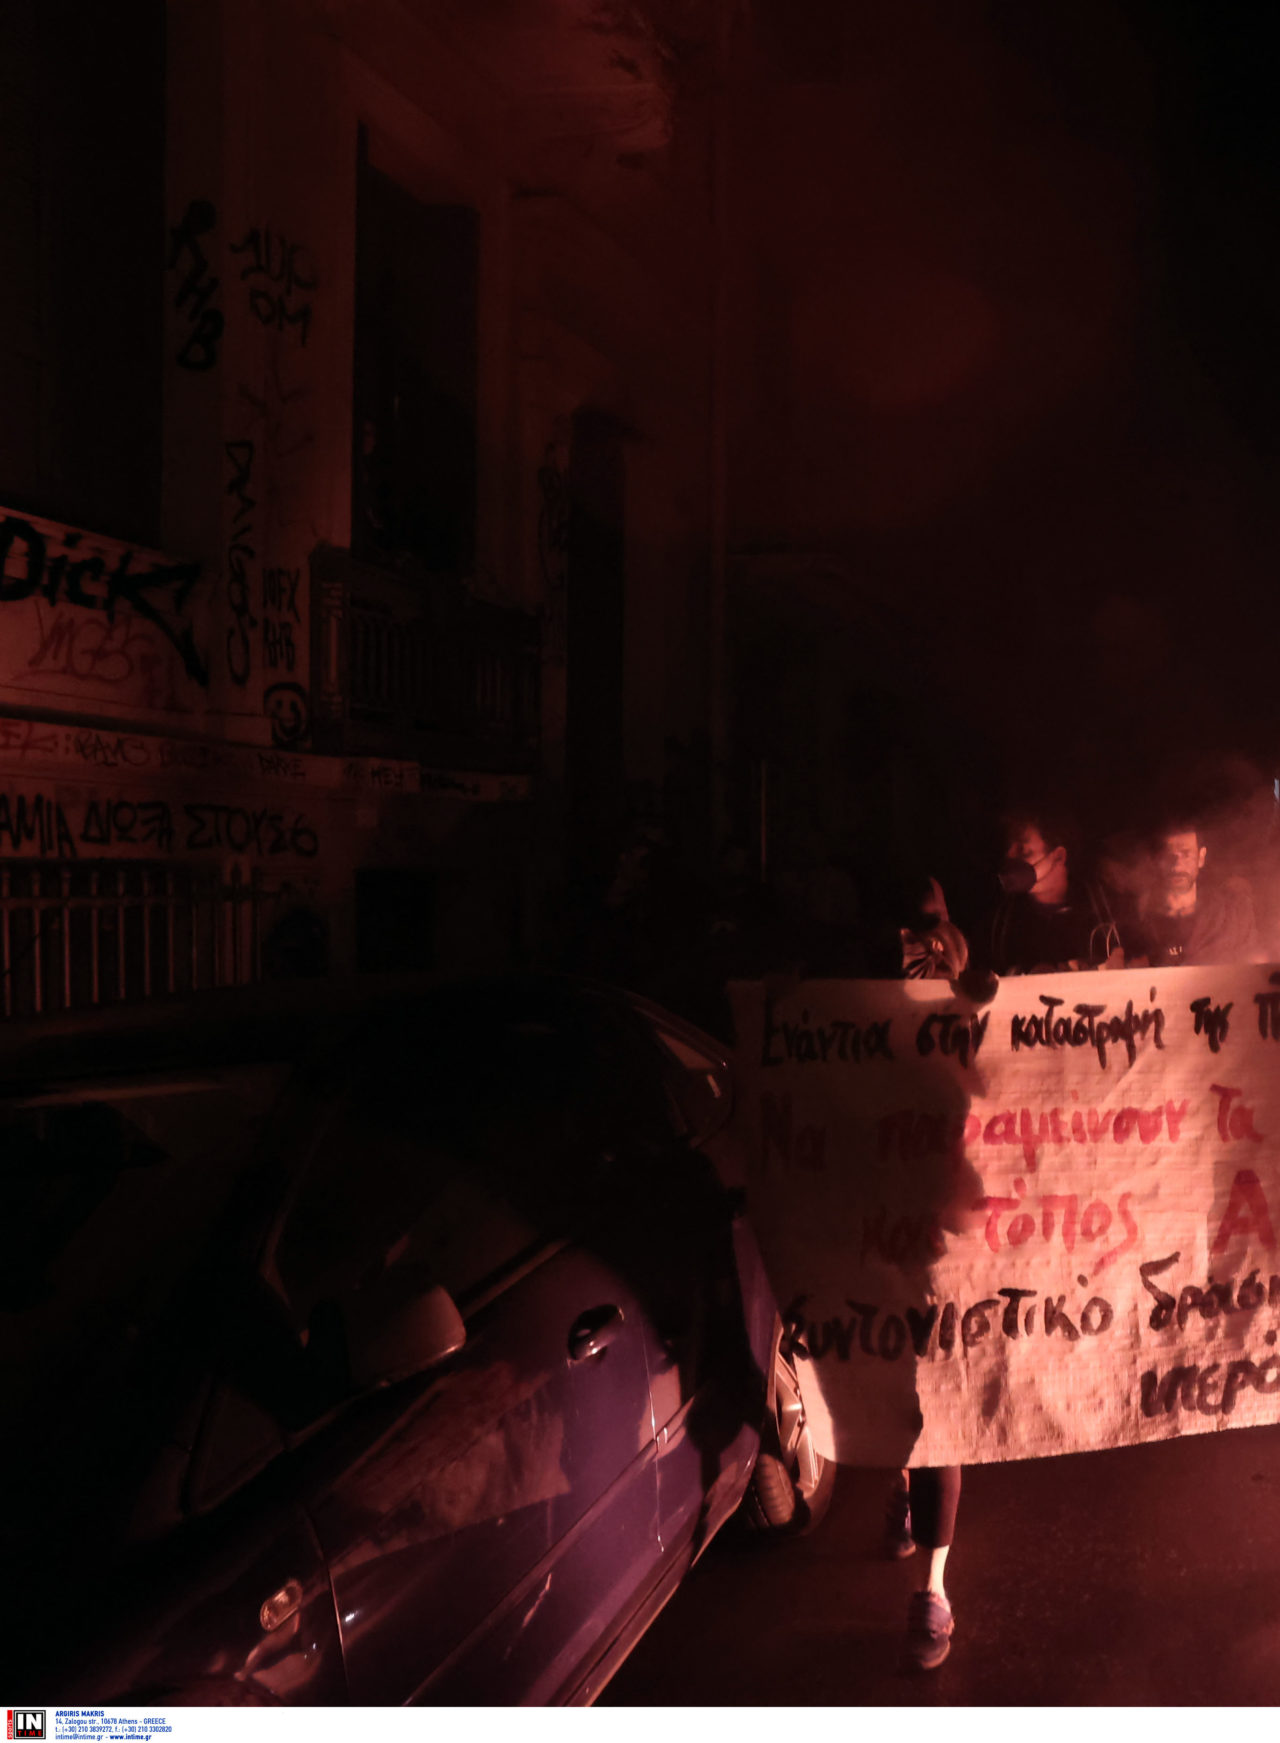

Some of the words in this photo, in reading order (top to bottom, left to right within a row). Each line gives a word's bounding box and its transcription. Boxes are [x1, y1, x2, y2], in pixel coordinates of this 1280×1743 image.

[916, 1009, 990, 1068] στην
[1190, 996, 1234, 1053] της
[971, 1177, 1138, 1276] τόπος
